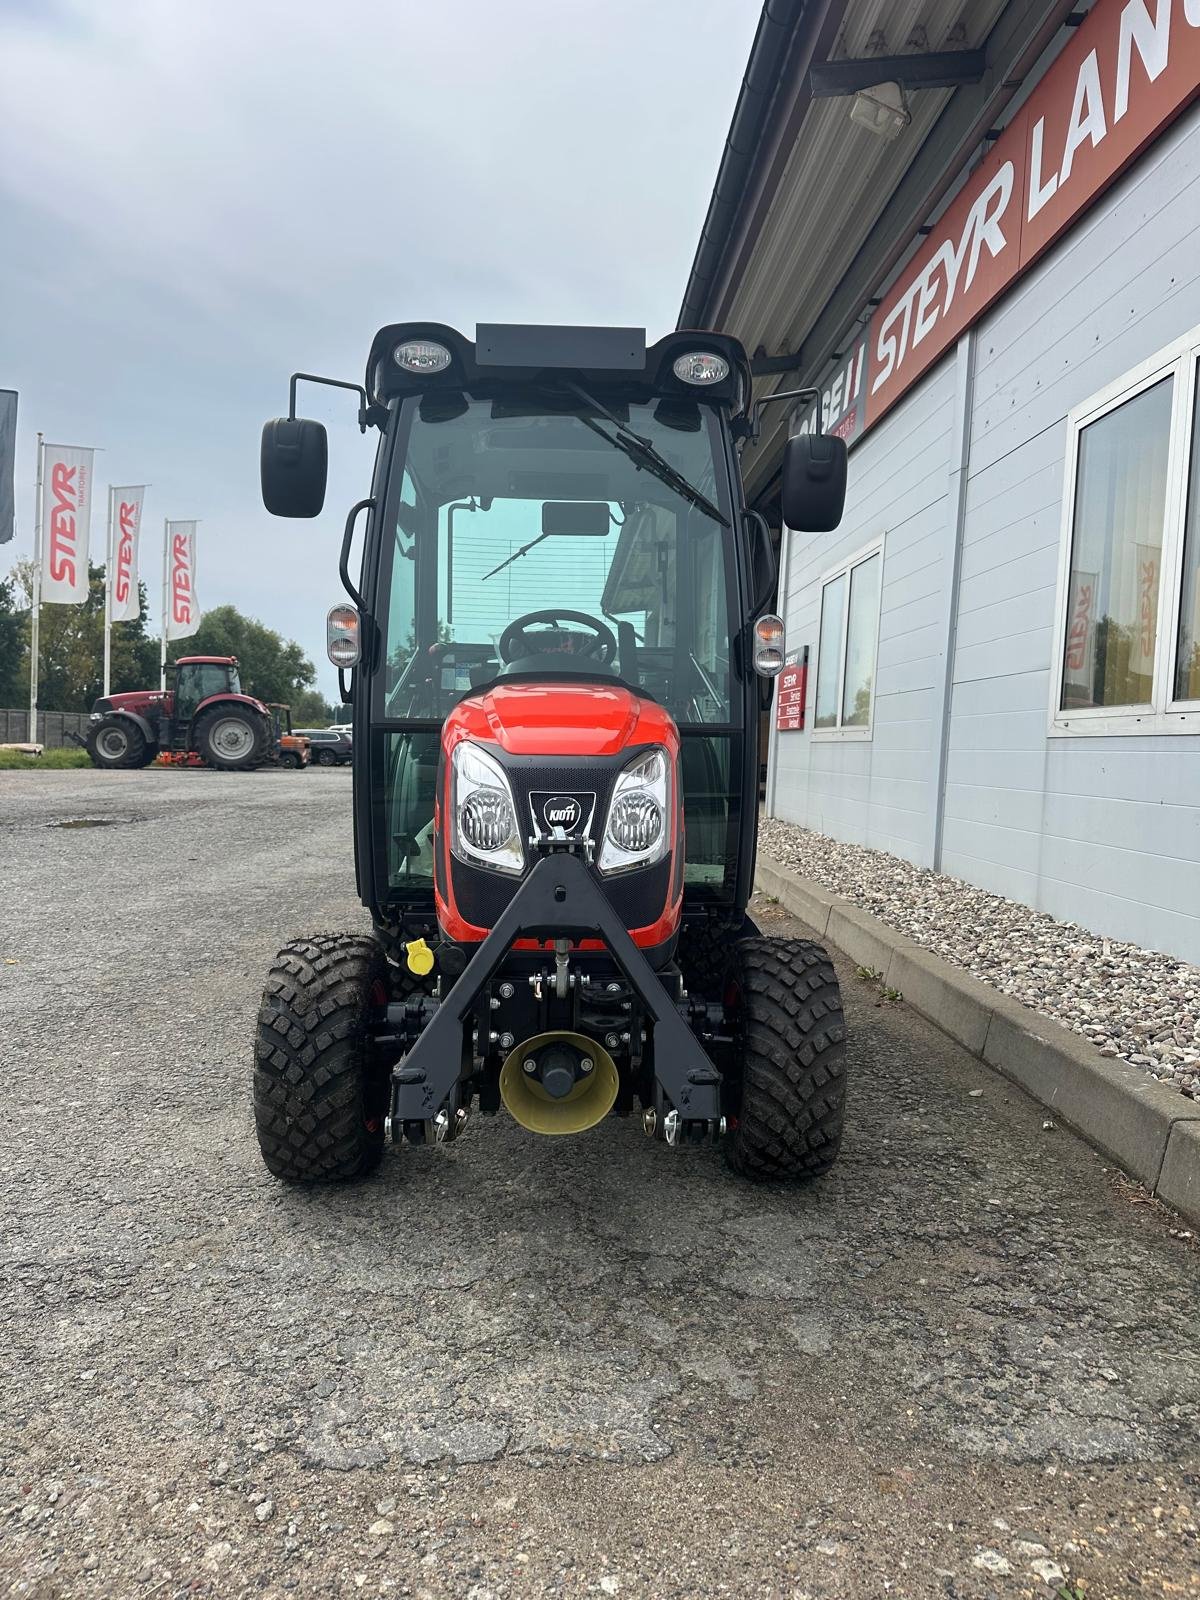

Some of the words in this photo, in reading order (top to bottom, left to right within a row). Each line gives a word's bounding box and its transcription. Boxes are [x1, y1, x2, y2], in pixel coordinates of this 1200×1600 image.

[871, 160, 1014, 396] STEYR
[1028, 0, 1200, 223] LAN
[50, 462, 77, 588] STEYR
[78, 465, 86, 507] TRAKTOREN
[116, 502, 136, 604] STEYR
[172, 534, 191, 625] STEYR
[549, 810, 575, 821] KIOTI
